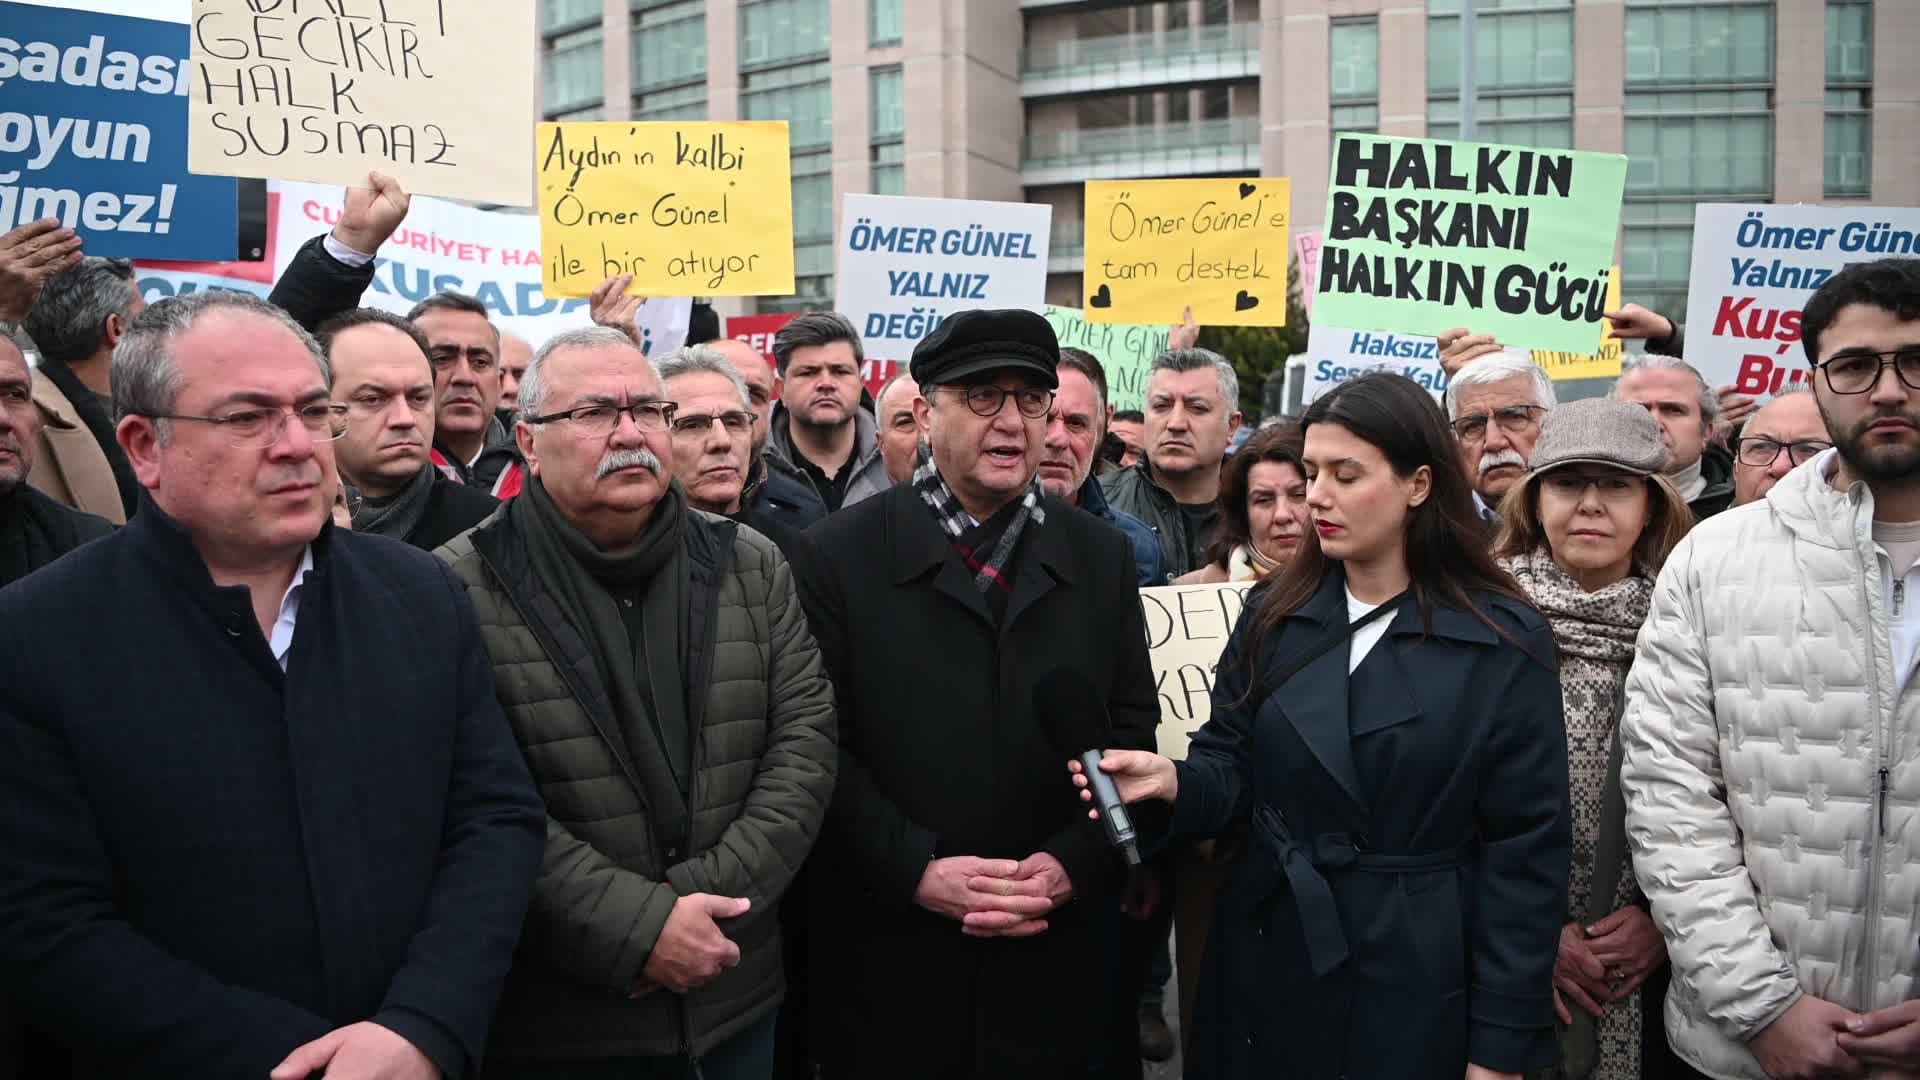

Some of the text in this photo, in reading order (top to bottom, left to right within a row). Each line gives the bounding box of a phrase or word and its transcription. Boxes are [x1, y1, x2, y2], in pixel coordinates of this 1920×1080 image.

[200, 63, 363, 115] HALK
[0, 111, 151, 170] oyun
[211, 112, 457, 166] SUSMAZ
[1335, 138, 1572, 197] HALKIN
[303, 200, 492, 265] CUURİYET
[849, 218, 1037, 259] ÖMER GÜNEL
[1329, 192, 1529, 251] BAŞKANI
[1736, 212, 1836, 251] Ömer
[552, 242, 759, 290] ile bir atıyor
[888, 270, 990, 299] YALNIZ
[1102, 257, 1158, 280] tam
[1176, 248, 1271, 282] destek
[1319, 246, 1486, 310] HALKIN
[1494, 262, 1609, 323] GÜCÜ
[1730, 257, 1832, 290] Yalnız
[1350, 332, 1440, 360] Haksız
